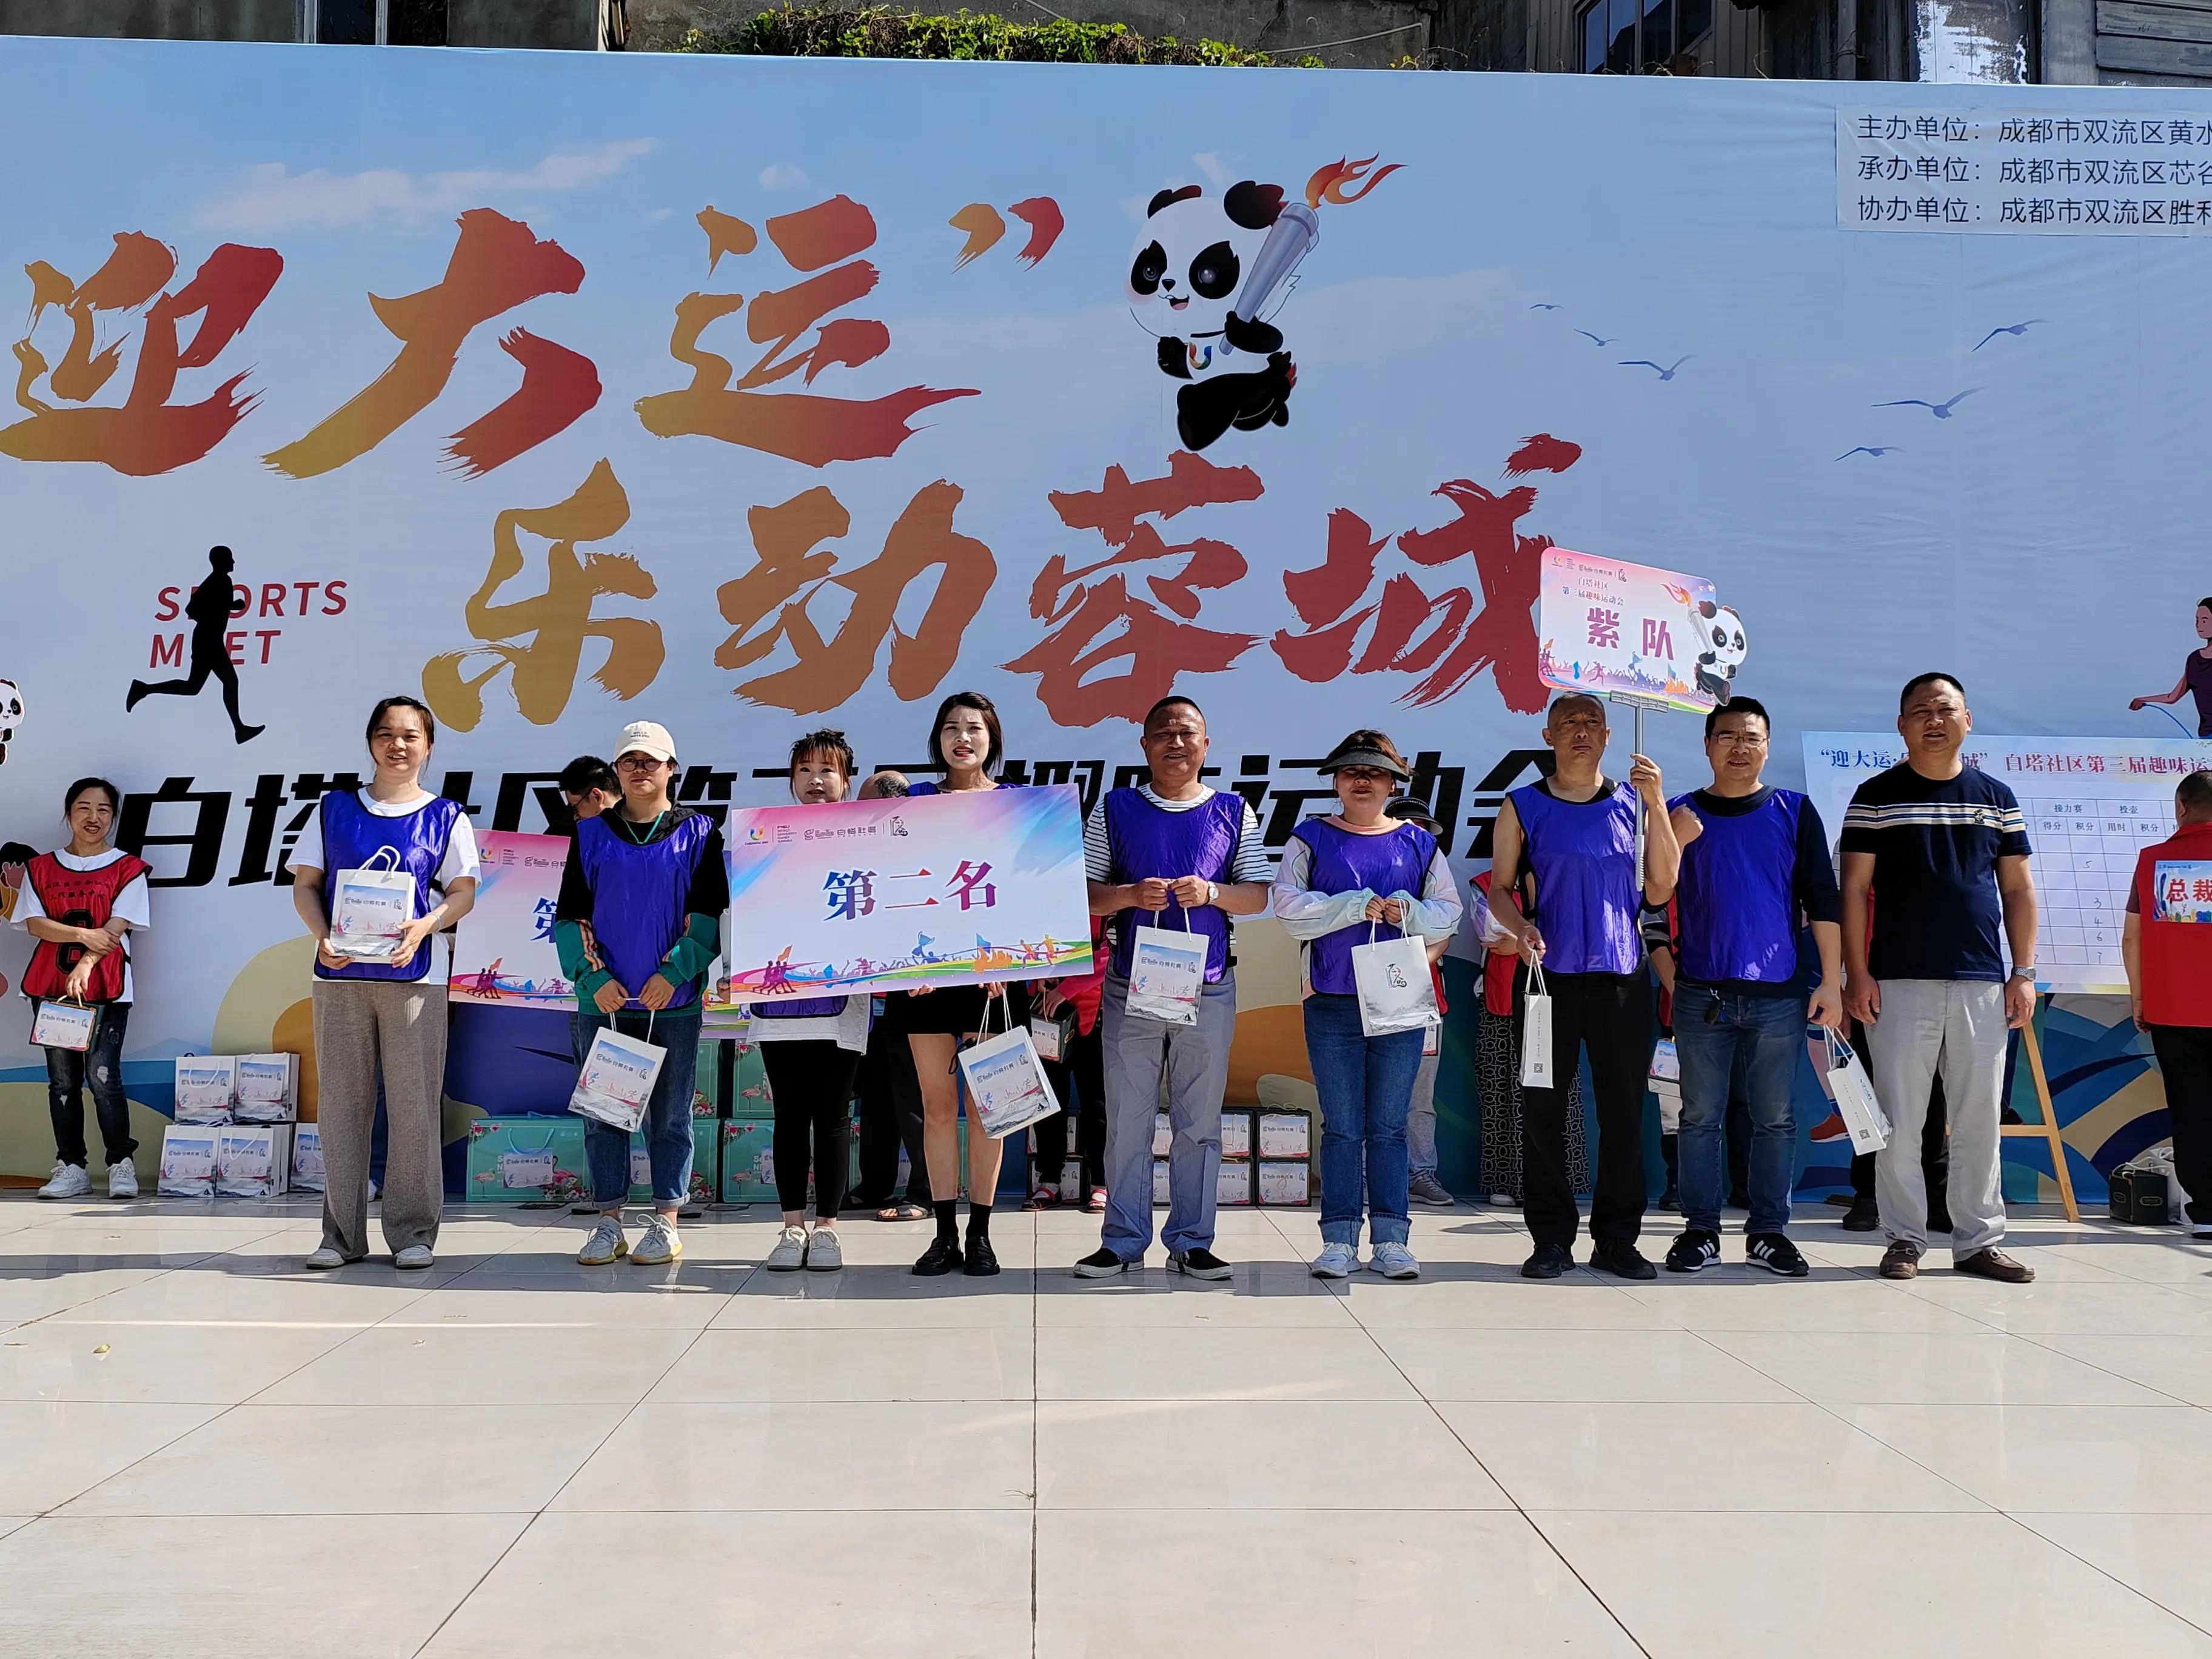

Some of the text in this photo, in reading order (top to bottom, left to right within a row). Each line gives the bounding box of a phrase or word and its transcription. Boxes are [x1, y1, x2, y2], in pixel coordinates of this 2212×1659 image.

[155, 580, 347, 622] SORTS
[423, 434, 1582, 732] 乐动蓉城
[150, 629, 281, 668] MET
[2005, 752, 2212, 775] 白塔社区第三届趣味运
[822, 860, 997, 922] 第二名
[2094, 916, 2103, 928] 4
[2096, 931, 2103, 942] 6
